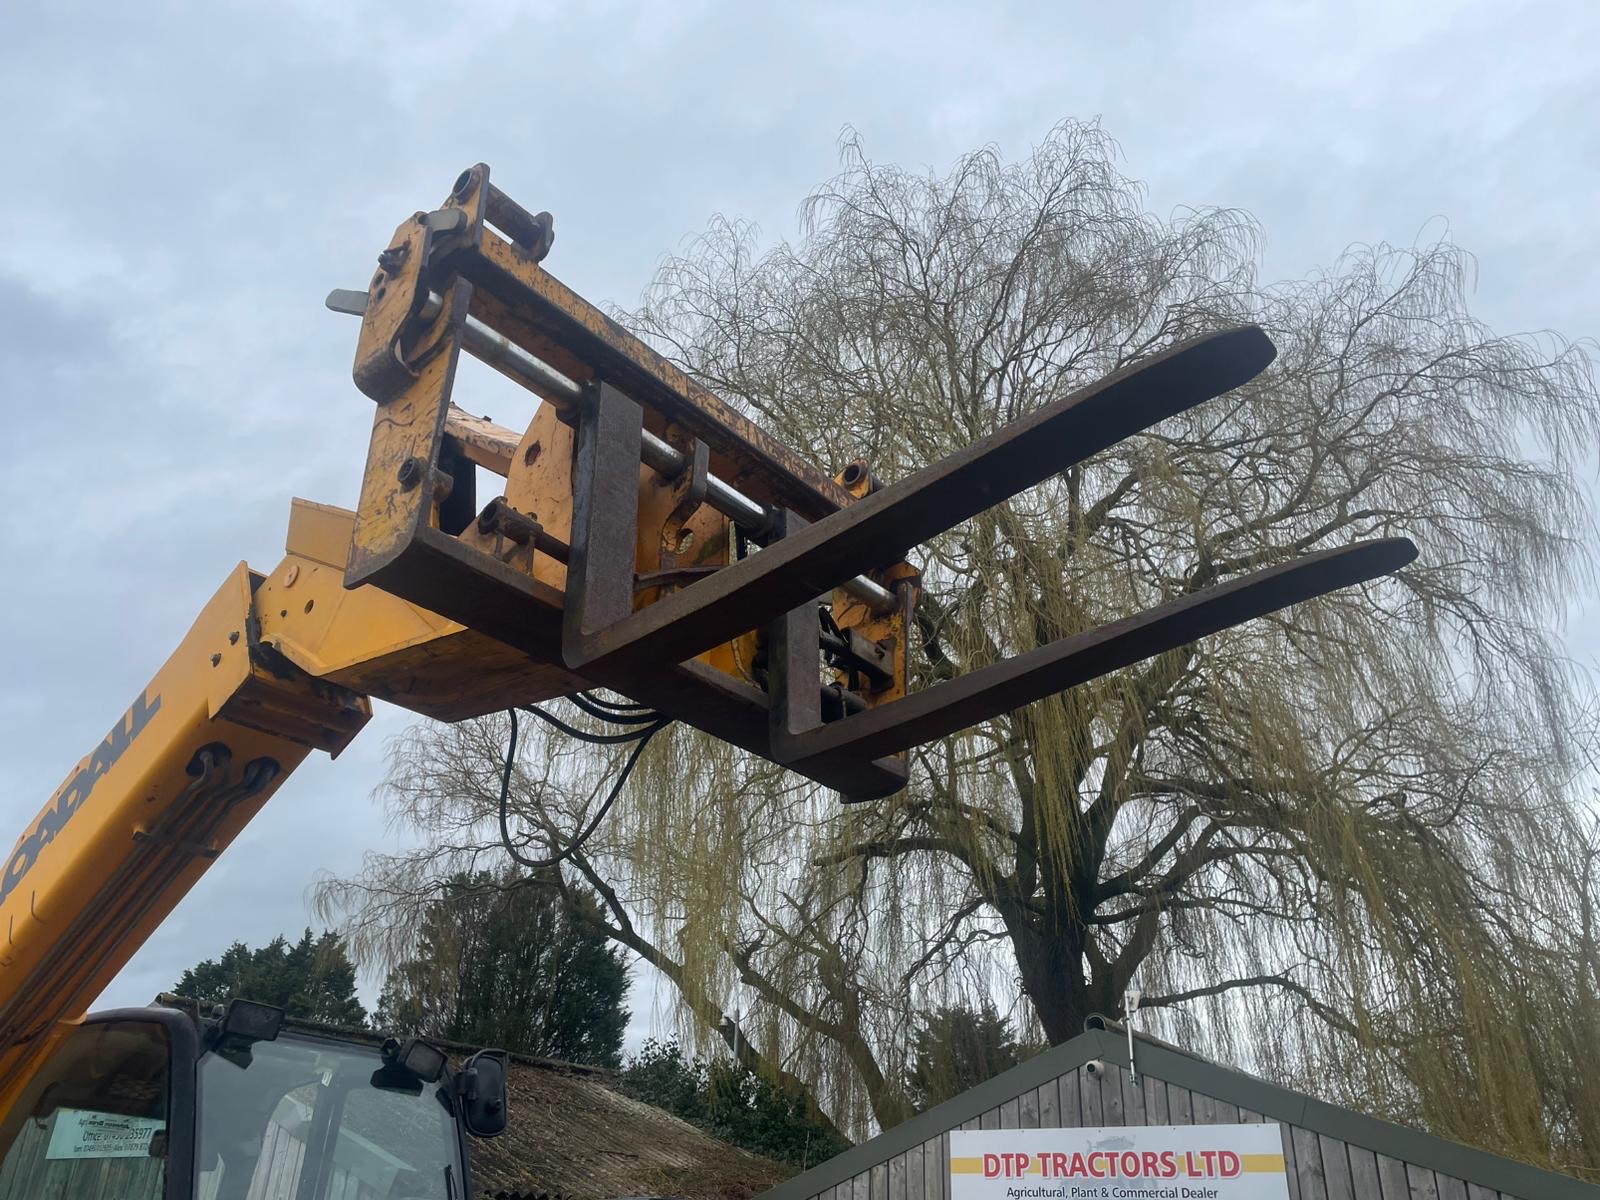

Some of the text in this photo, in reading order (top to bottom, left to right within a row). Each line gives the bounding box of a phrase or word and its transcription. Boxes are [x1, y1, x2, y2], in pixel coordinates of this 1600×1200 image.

[0, 690, 161, 907] OADALL
[983, 1150, 1241, 1179] DTP TRACTORS LTD
[1006, 1186, 1219, 1200] Agricultural, Plant & Commercial Dealer
